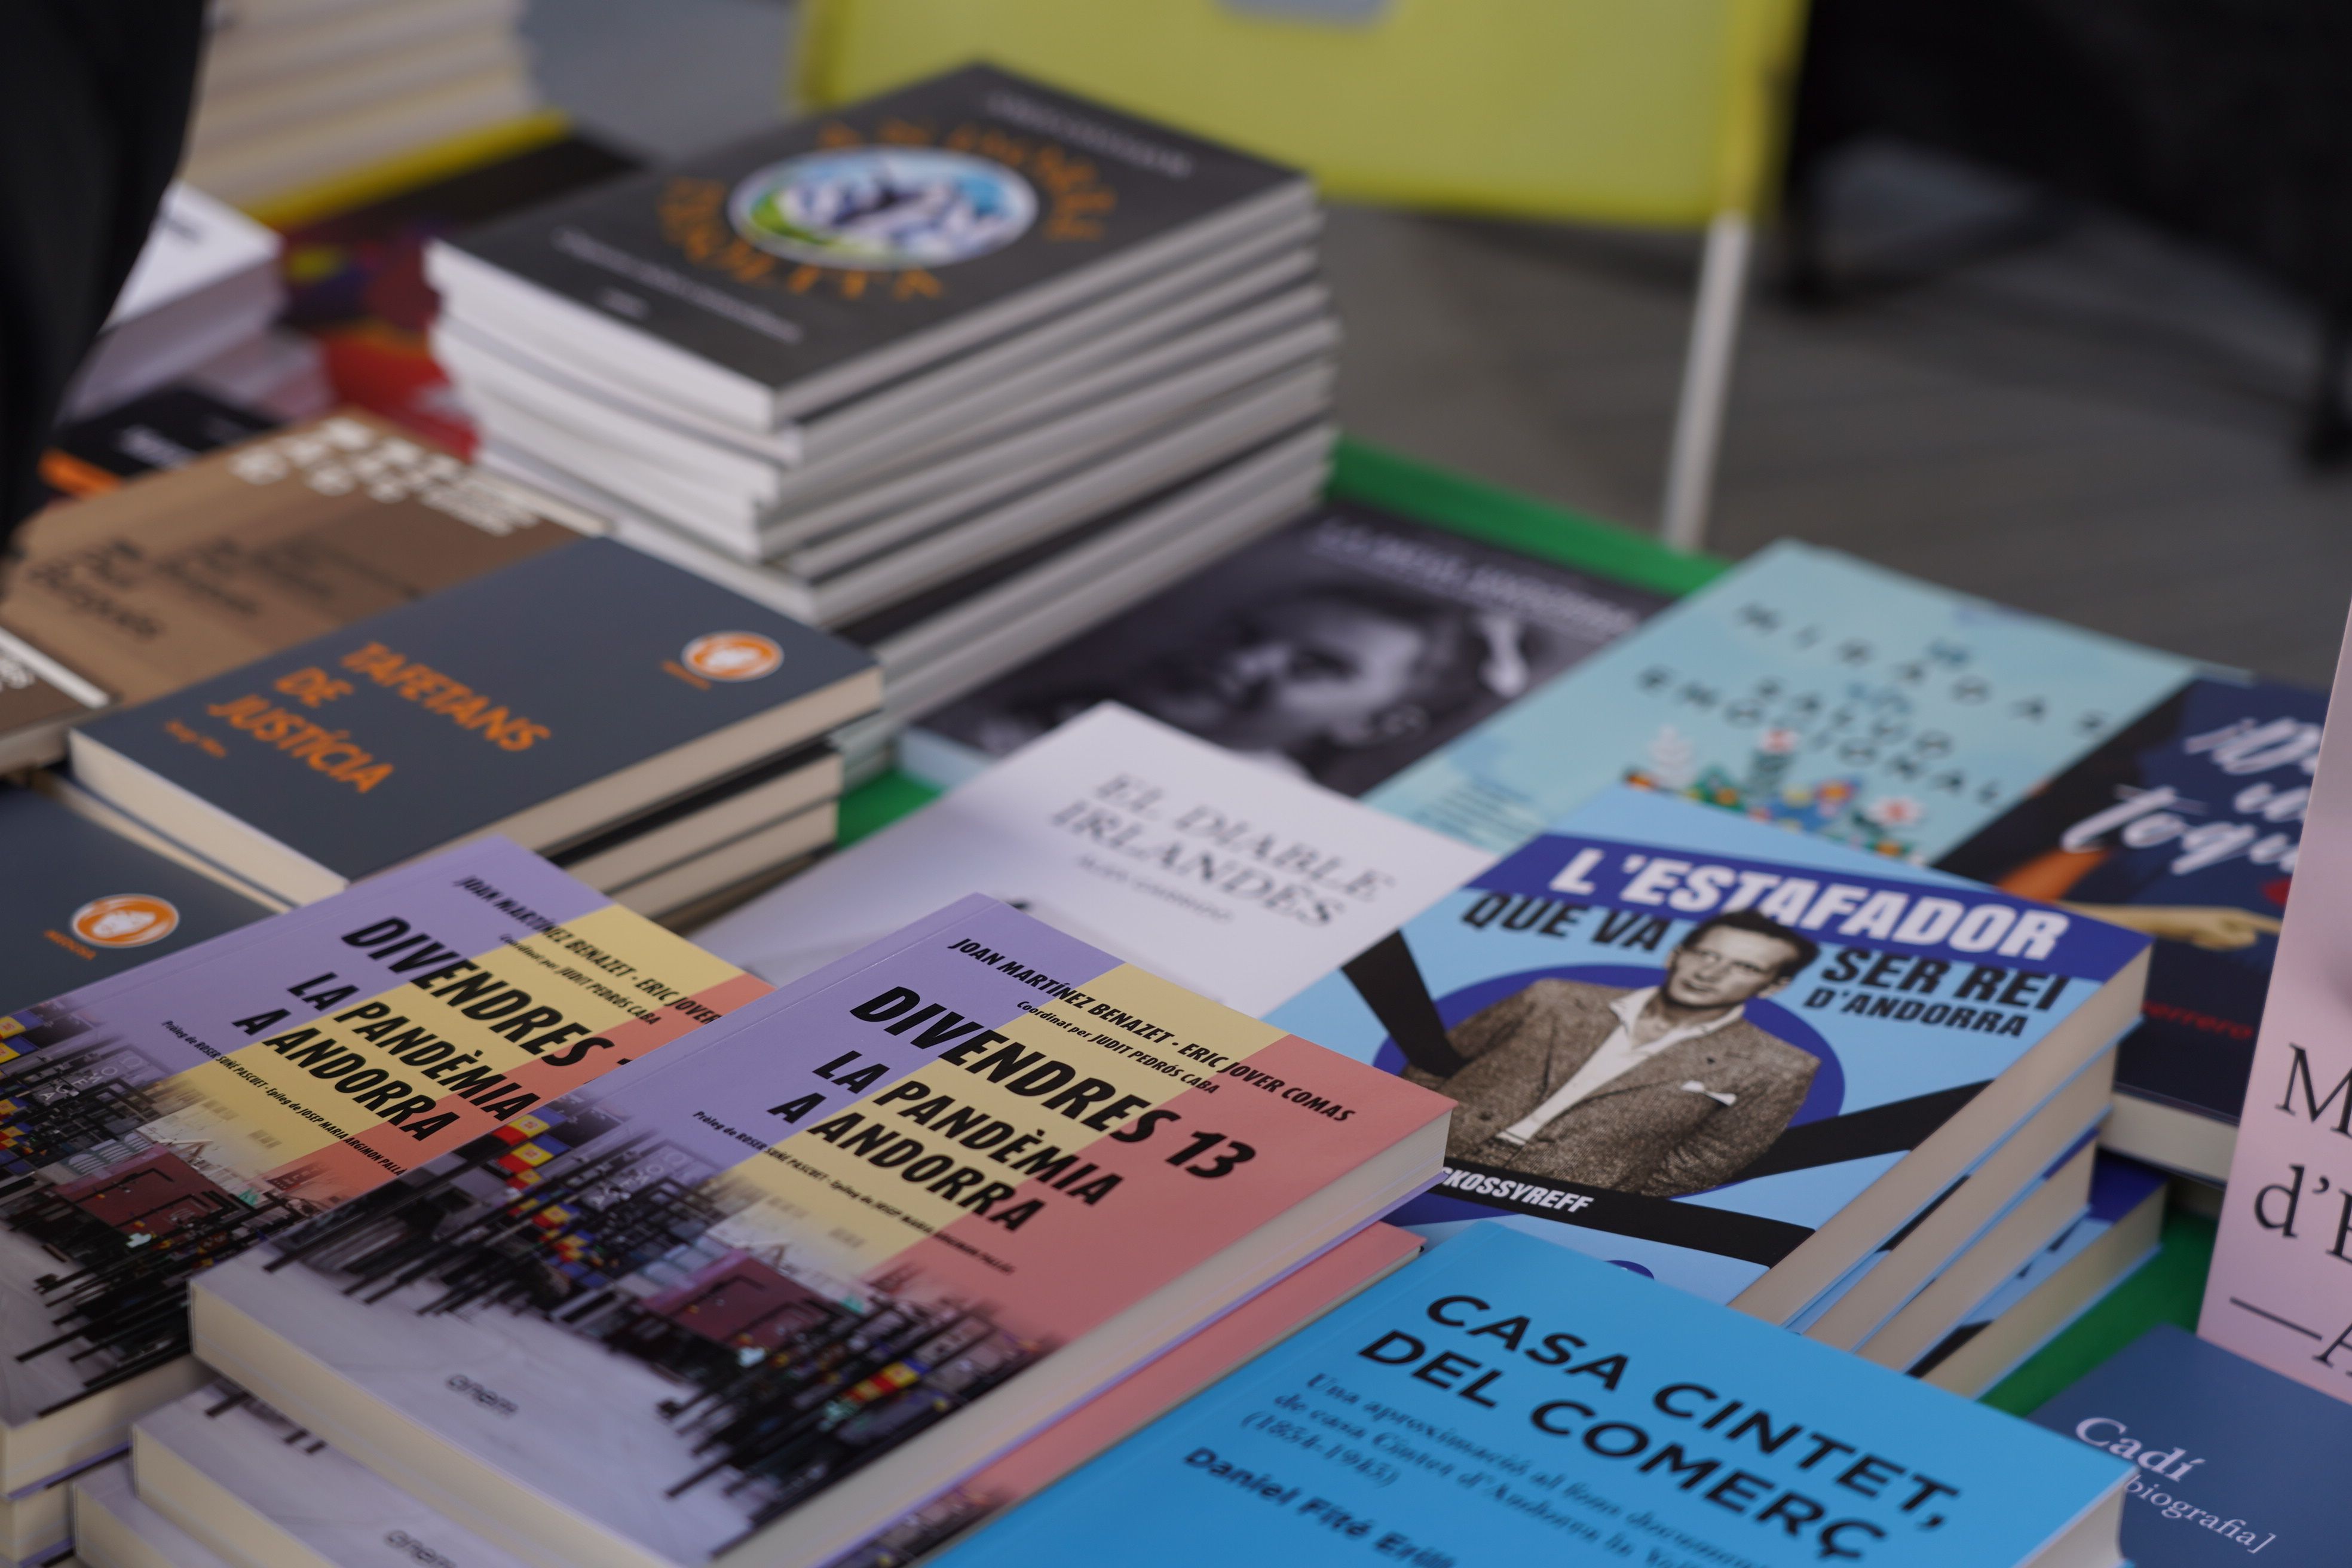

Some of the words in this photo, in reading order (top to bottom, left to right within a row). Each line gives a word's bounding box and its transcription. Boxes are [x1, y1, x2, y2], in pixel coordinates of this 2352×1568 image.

[274, 667, 353, 708] DE
[341, 642, 550, 751] TAFETANS
[209, 696, 393, 794] JUSTÍCIA
[1173, 804, 1396, 904] DIABLE
[1461, 892, 1590, 939] QUE
[1590, 906, 1672, 952] VA
[1549, 849, 2069, 961] L'ESTAFADOR
[341, 917, 615, 1066] DIVENDRES
[565, 939, 636, 979] BENAZET
[635, 978, 679, 1006] ERIC
[627, 1005, 662, 1025] CABA
[1803, 987, 2029, 1039] D'ANDORRA
[1821, 946, 1952, 999] SER
[1953, 964, 2072, 1012] REI
[232, 1008, 292, 1036] A
[262, 1027, 460, 1141] ANDORRA
[288, 972, 359, 1011] LA
[334, 1002, 541, 1121] PANDÈMIA
[948, 938, 1004, 967] JOAN
[997, 961, 1096, 1009] MARTÍNEZ
[1089, 1003, 1175, 1045] BENAZET
[1177, 1043, 1228, 1068] ERIC
[1217, 1061, 1285, 1096] JOVER
[1282, 1087, 1356, 1123] COMAS
[1017, 1001, 1072, 1030] Coordinat
[1070, 1023, 1092, 1039] per
[1088, 1034, 1132, 1056] JUDIT
[1132, 1049, 1184, 1079] PEDRÓS
[1181, 1073, 1221, 1094] CABA
[183, 1034, 197, 1046] de
[288, 1102, 301, 1111] de
[296, 1108, 324, 1124] JOSEP
[319, 1122, 348, 1139] MARIA
[343, 1137, 384, 1161] ARGIMON
[724, 1125, 737, 1137] de
[812, 1051, 890, 1094] LA
[872, 1080, 1123, 1206] PANDÈMIA
[849, 986, 1181, 1142] DIVENDRES
[1165, 1130, 1256, 1179] 13
[767, 1092, 826, 1124] A
[807, 1112, 1046, 1232] ANDORRA
[1273, 1394, 1307, 1413] de
[1310, 1410, 1366, 1439] casa
[1307, 1373, 1360, 1404] Una
[1426, 1295, 1629, 1391] CASA
[1652, 1382, 1961, 1530] CINTET,
[1183, 1446, 1301, 1506] Daniel
[1296, 1495, 1376, 1539] Fité
[1358, 1330, 1503, 1408] DEL
[1530, 1399, 1886, 1560] COMERÇ
[2075, 1417, 2206, 1483] Cadí
